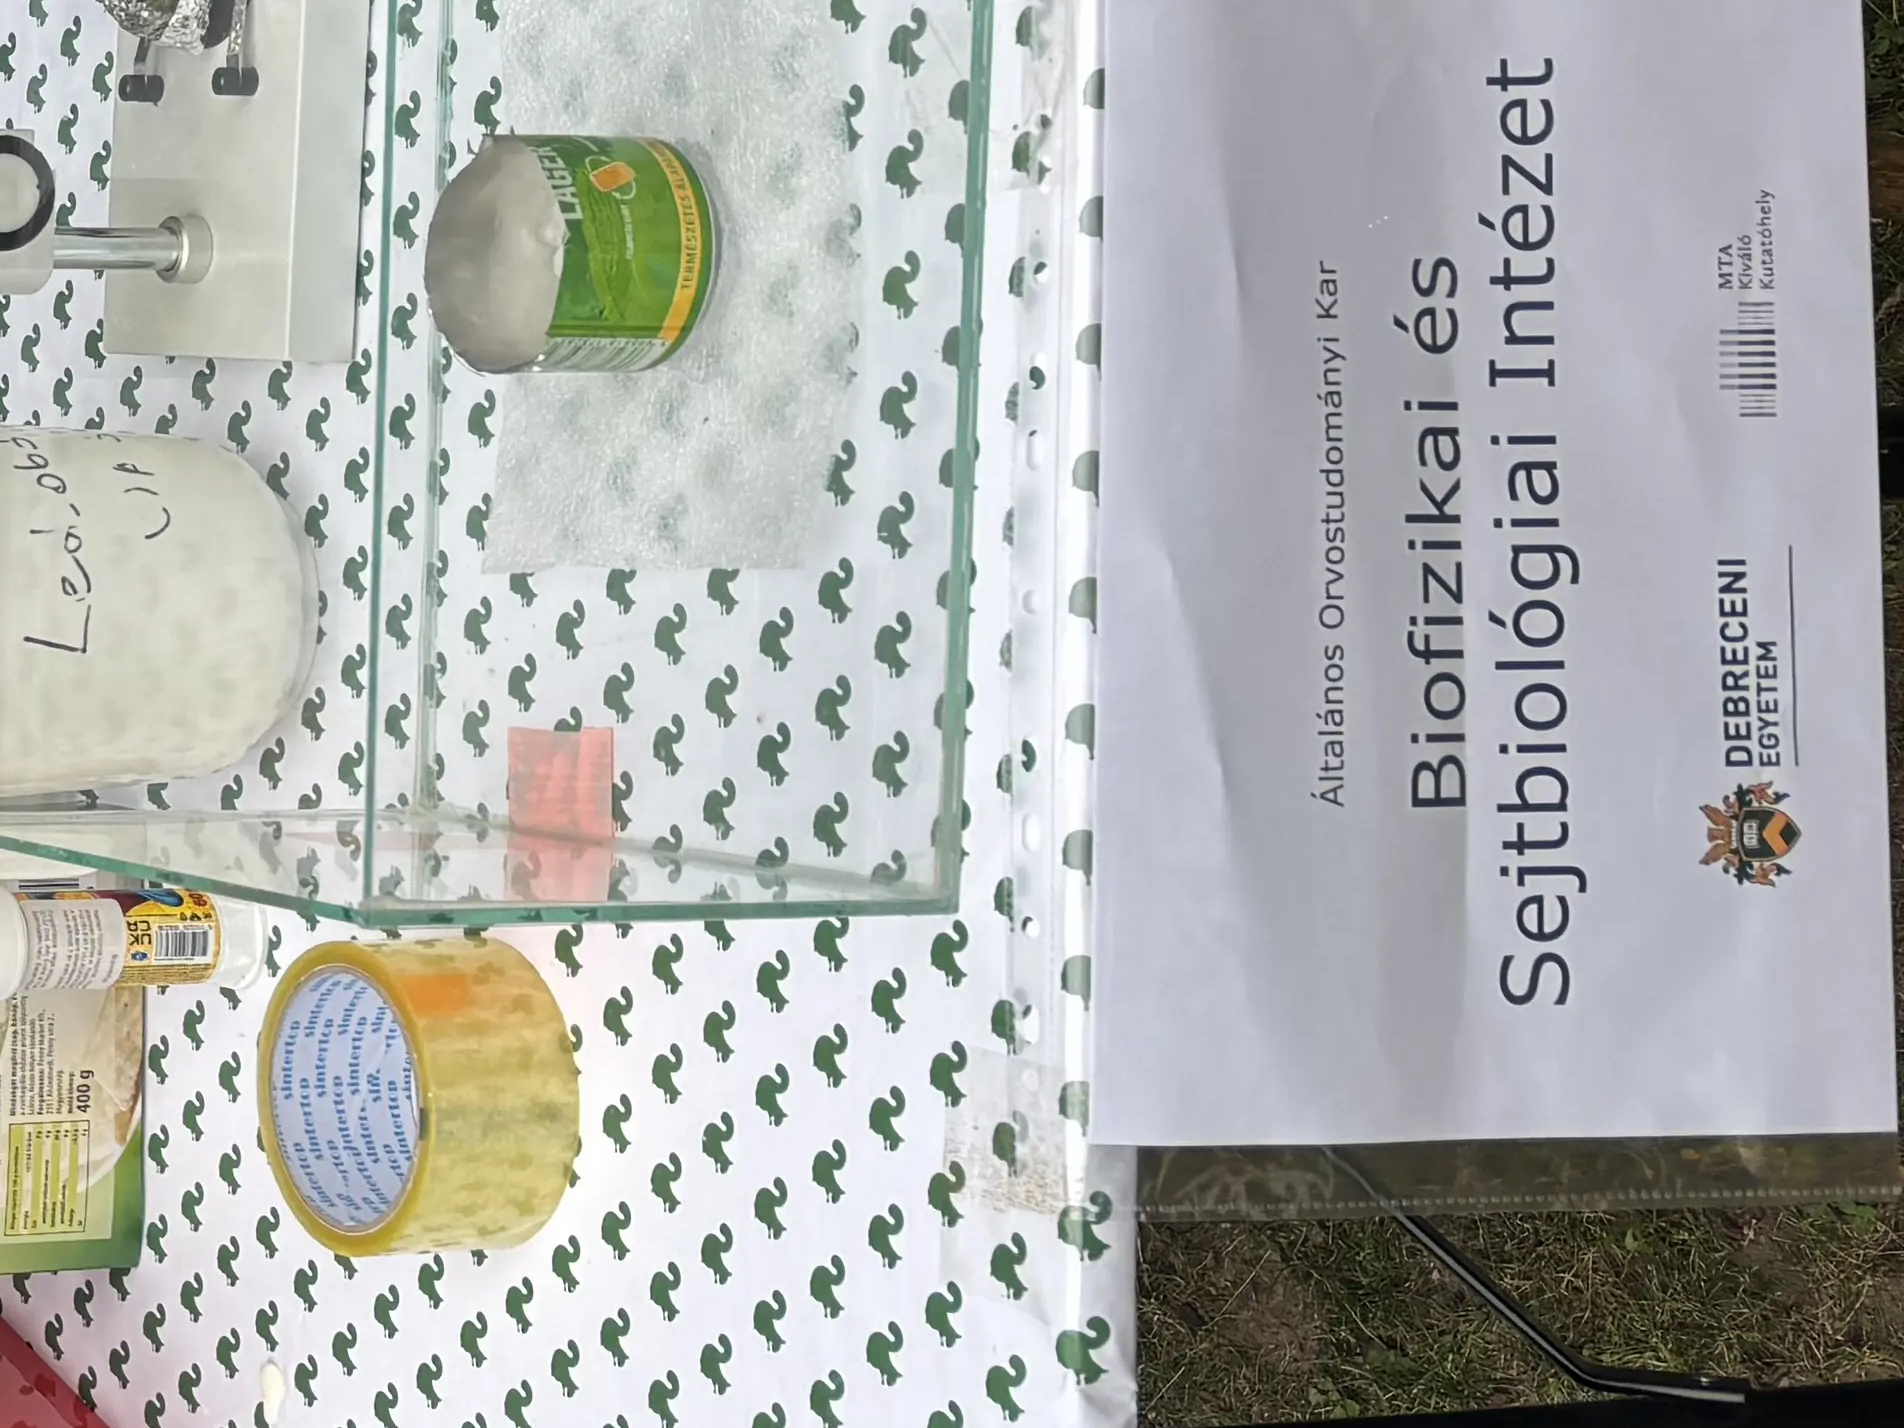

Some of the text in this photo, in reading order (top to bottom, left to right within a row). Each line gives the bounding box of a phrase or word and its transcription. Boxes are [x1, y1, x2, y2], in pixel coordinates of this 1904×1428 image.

[1717, 243, 1734, 291] MTA
[1736, 234, 1756, 291] Kiváló
[1756, 188, 1777, 291] Kutatóhely
[1310, 259, 1350, 808] Általános Orvostudományi Kar
[1395, 255, 1469, 811] Biofizikai és
[1480, 56, 1588, 1008] Sejtbiológiai Intézet
[1716, 558, 1755, 768] DEBRECENI
[1755, 640, 1781, 768] EGYETEM
[76, 1068, 95, 1114] 400 g
[314, 1018, 335, 1098] sintertop
[347, 1016, 368, 1096] sintertop
[299, 1077, 324, 1161] sintertop
